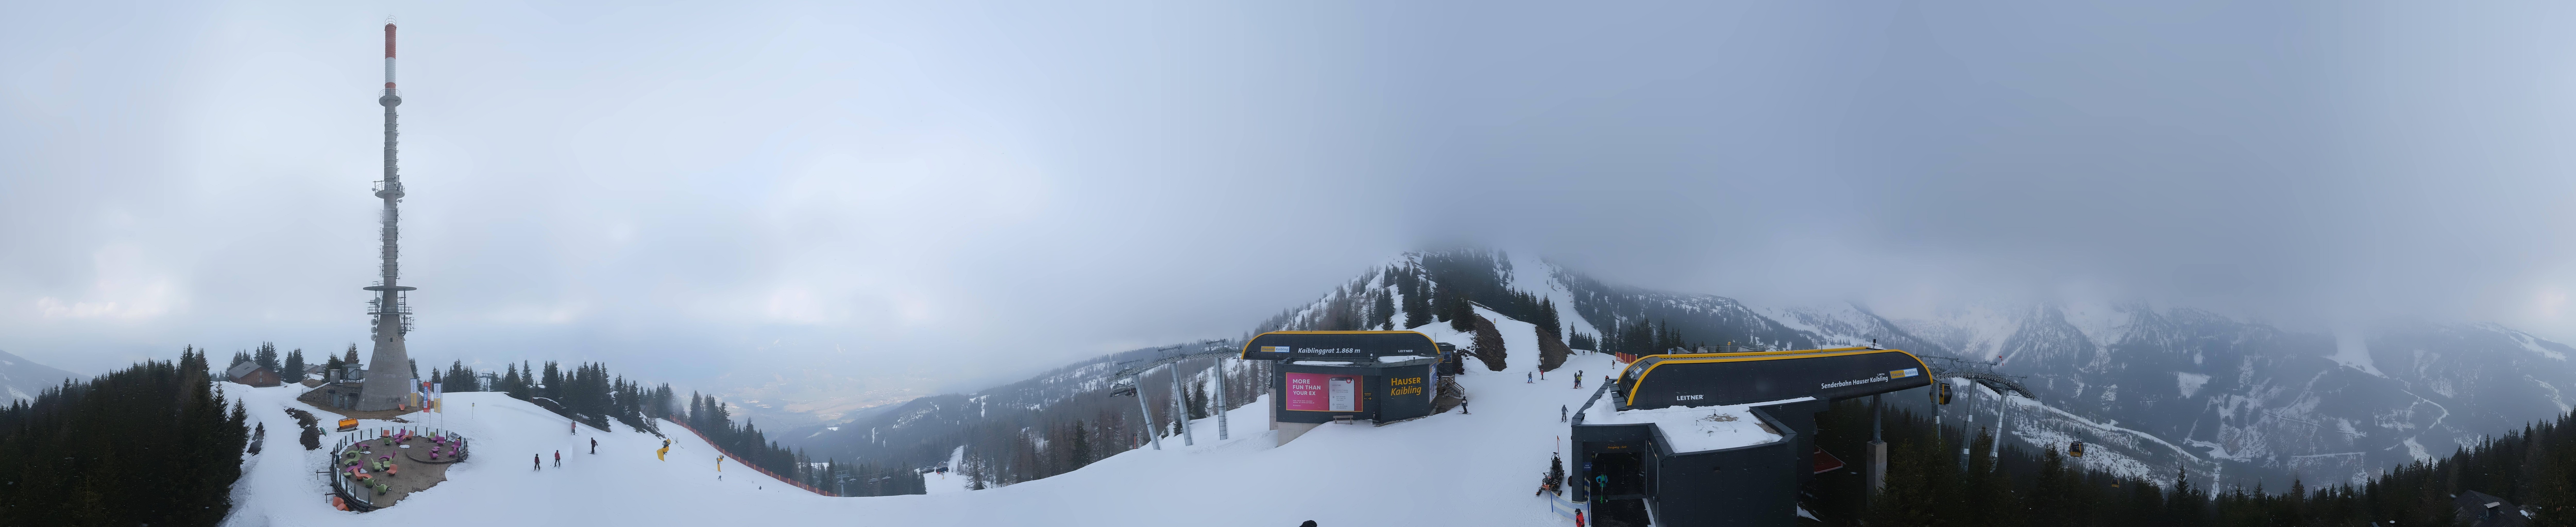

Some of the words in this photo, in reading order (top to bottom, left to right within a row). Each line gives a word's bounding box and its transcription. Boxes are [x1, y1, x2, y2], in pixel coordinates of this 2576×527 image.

[1391, 377, 1421, 386] HAUSER
[1821, 380, 1852, 389] Senderbahn
[1391, 386, 1421, 396] Kaibling
